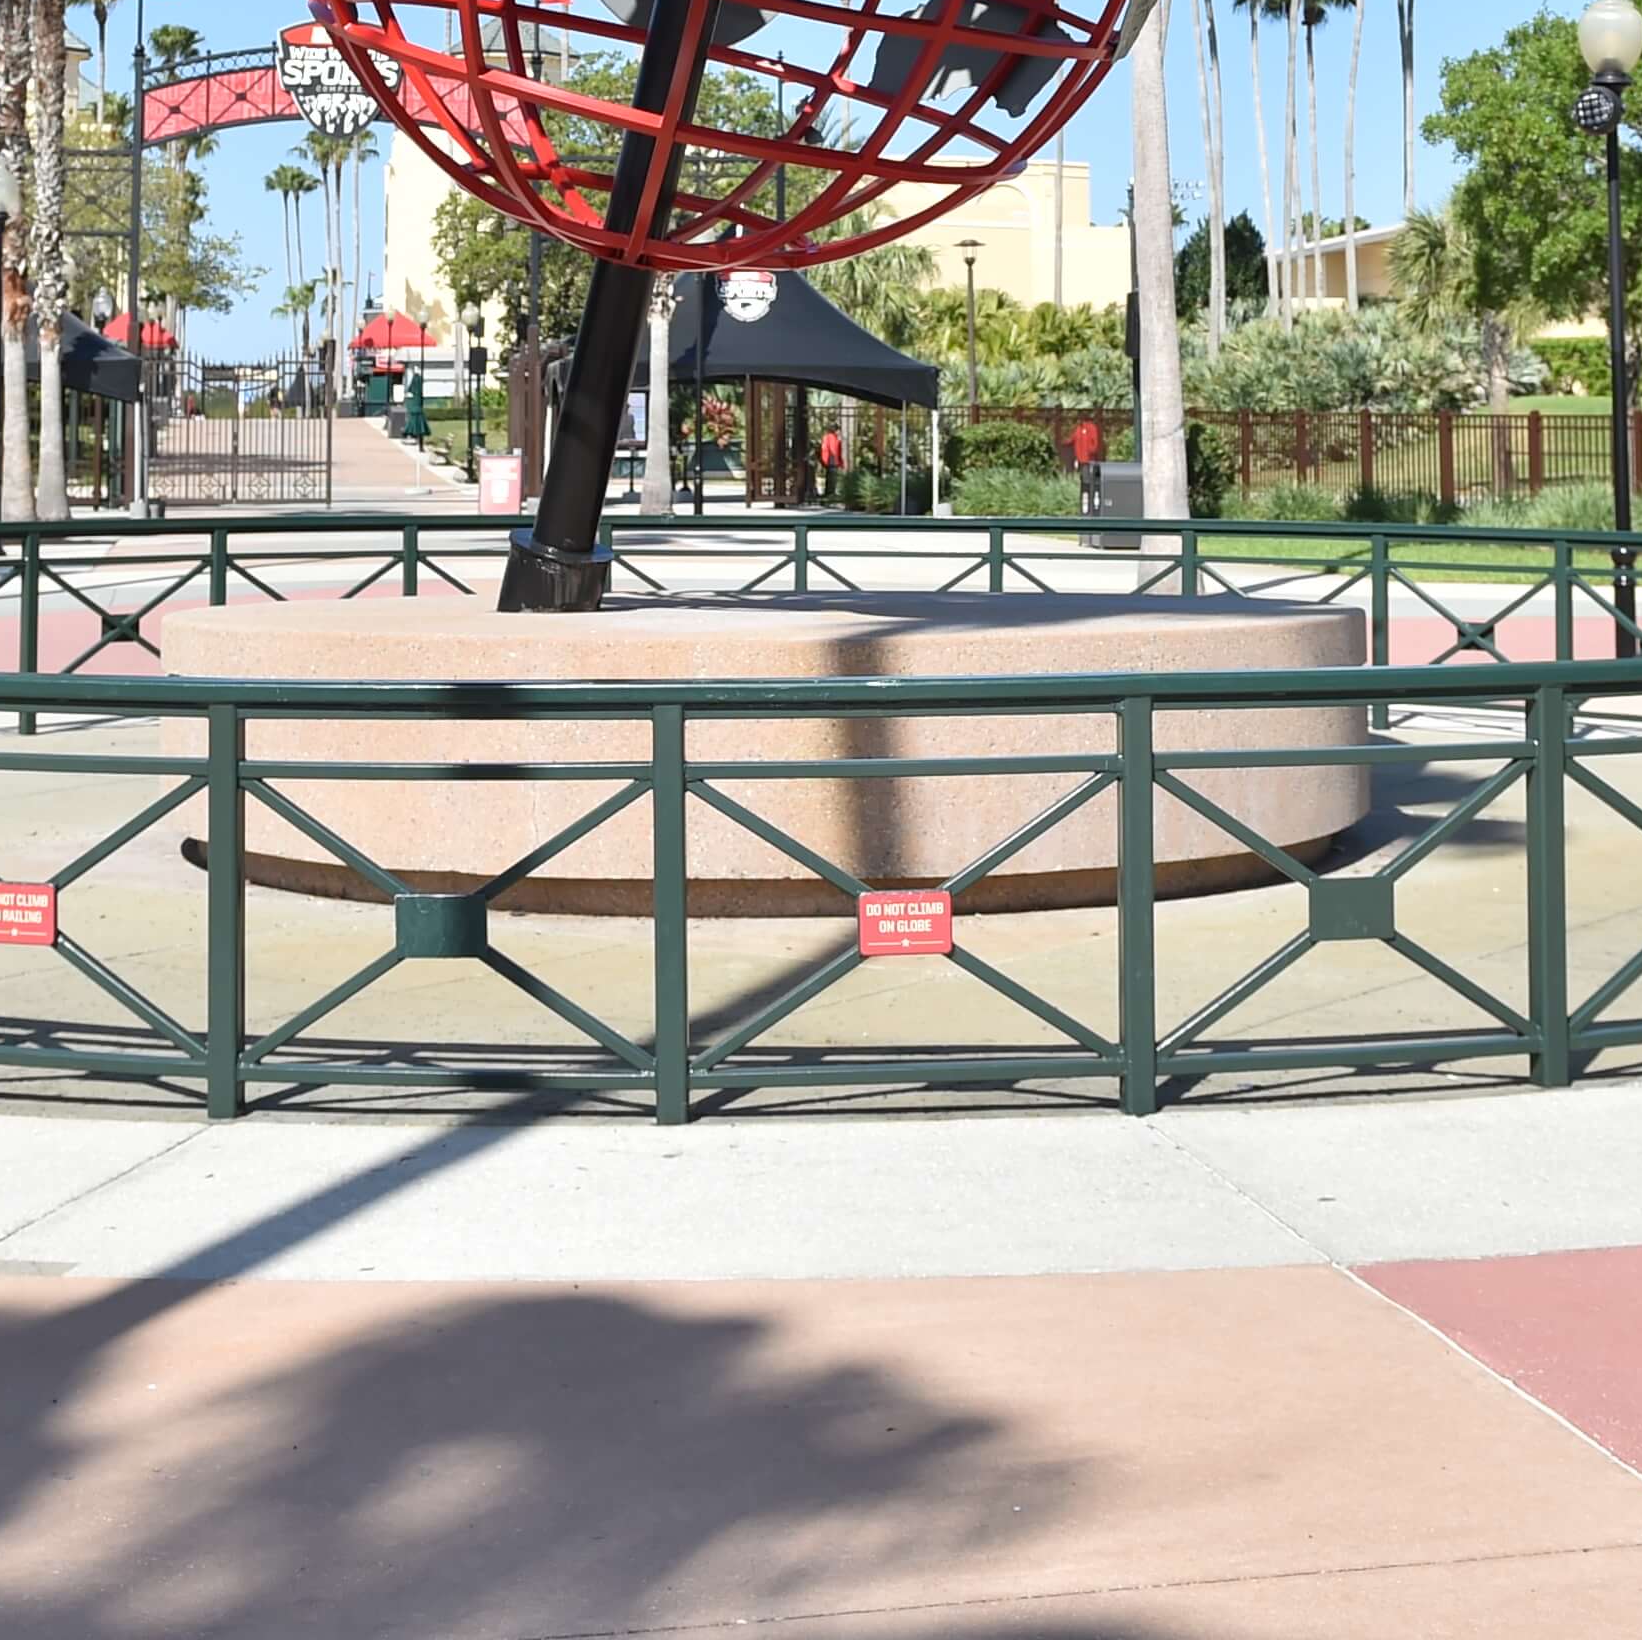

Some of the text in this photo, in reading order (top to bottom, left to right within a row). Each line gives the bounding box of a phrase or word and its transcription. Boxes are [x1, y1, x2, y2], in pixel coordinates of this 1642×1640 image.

[283, 60, 399, 88] SPORS
[17, 894, 49, 907] CLIMB
[866, 902, 944, 916] DO NOT CLIMB
[2, 909, 43, 924] RAILING
[879, 919, 933, 933] ON GLOBE
